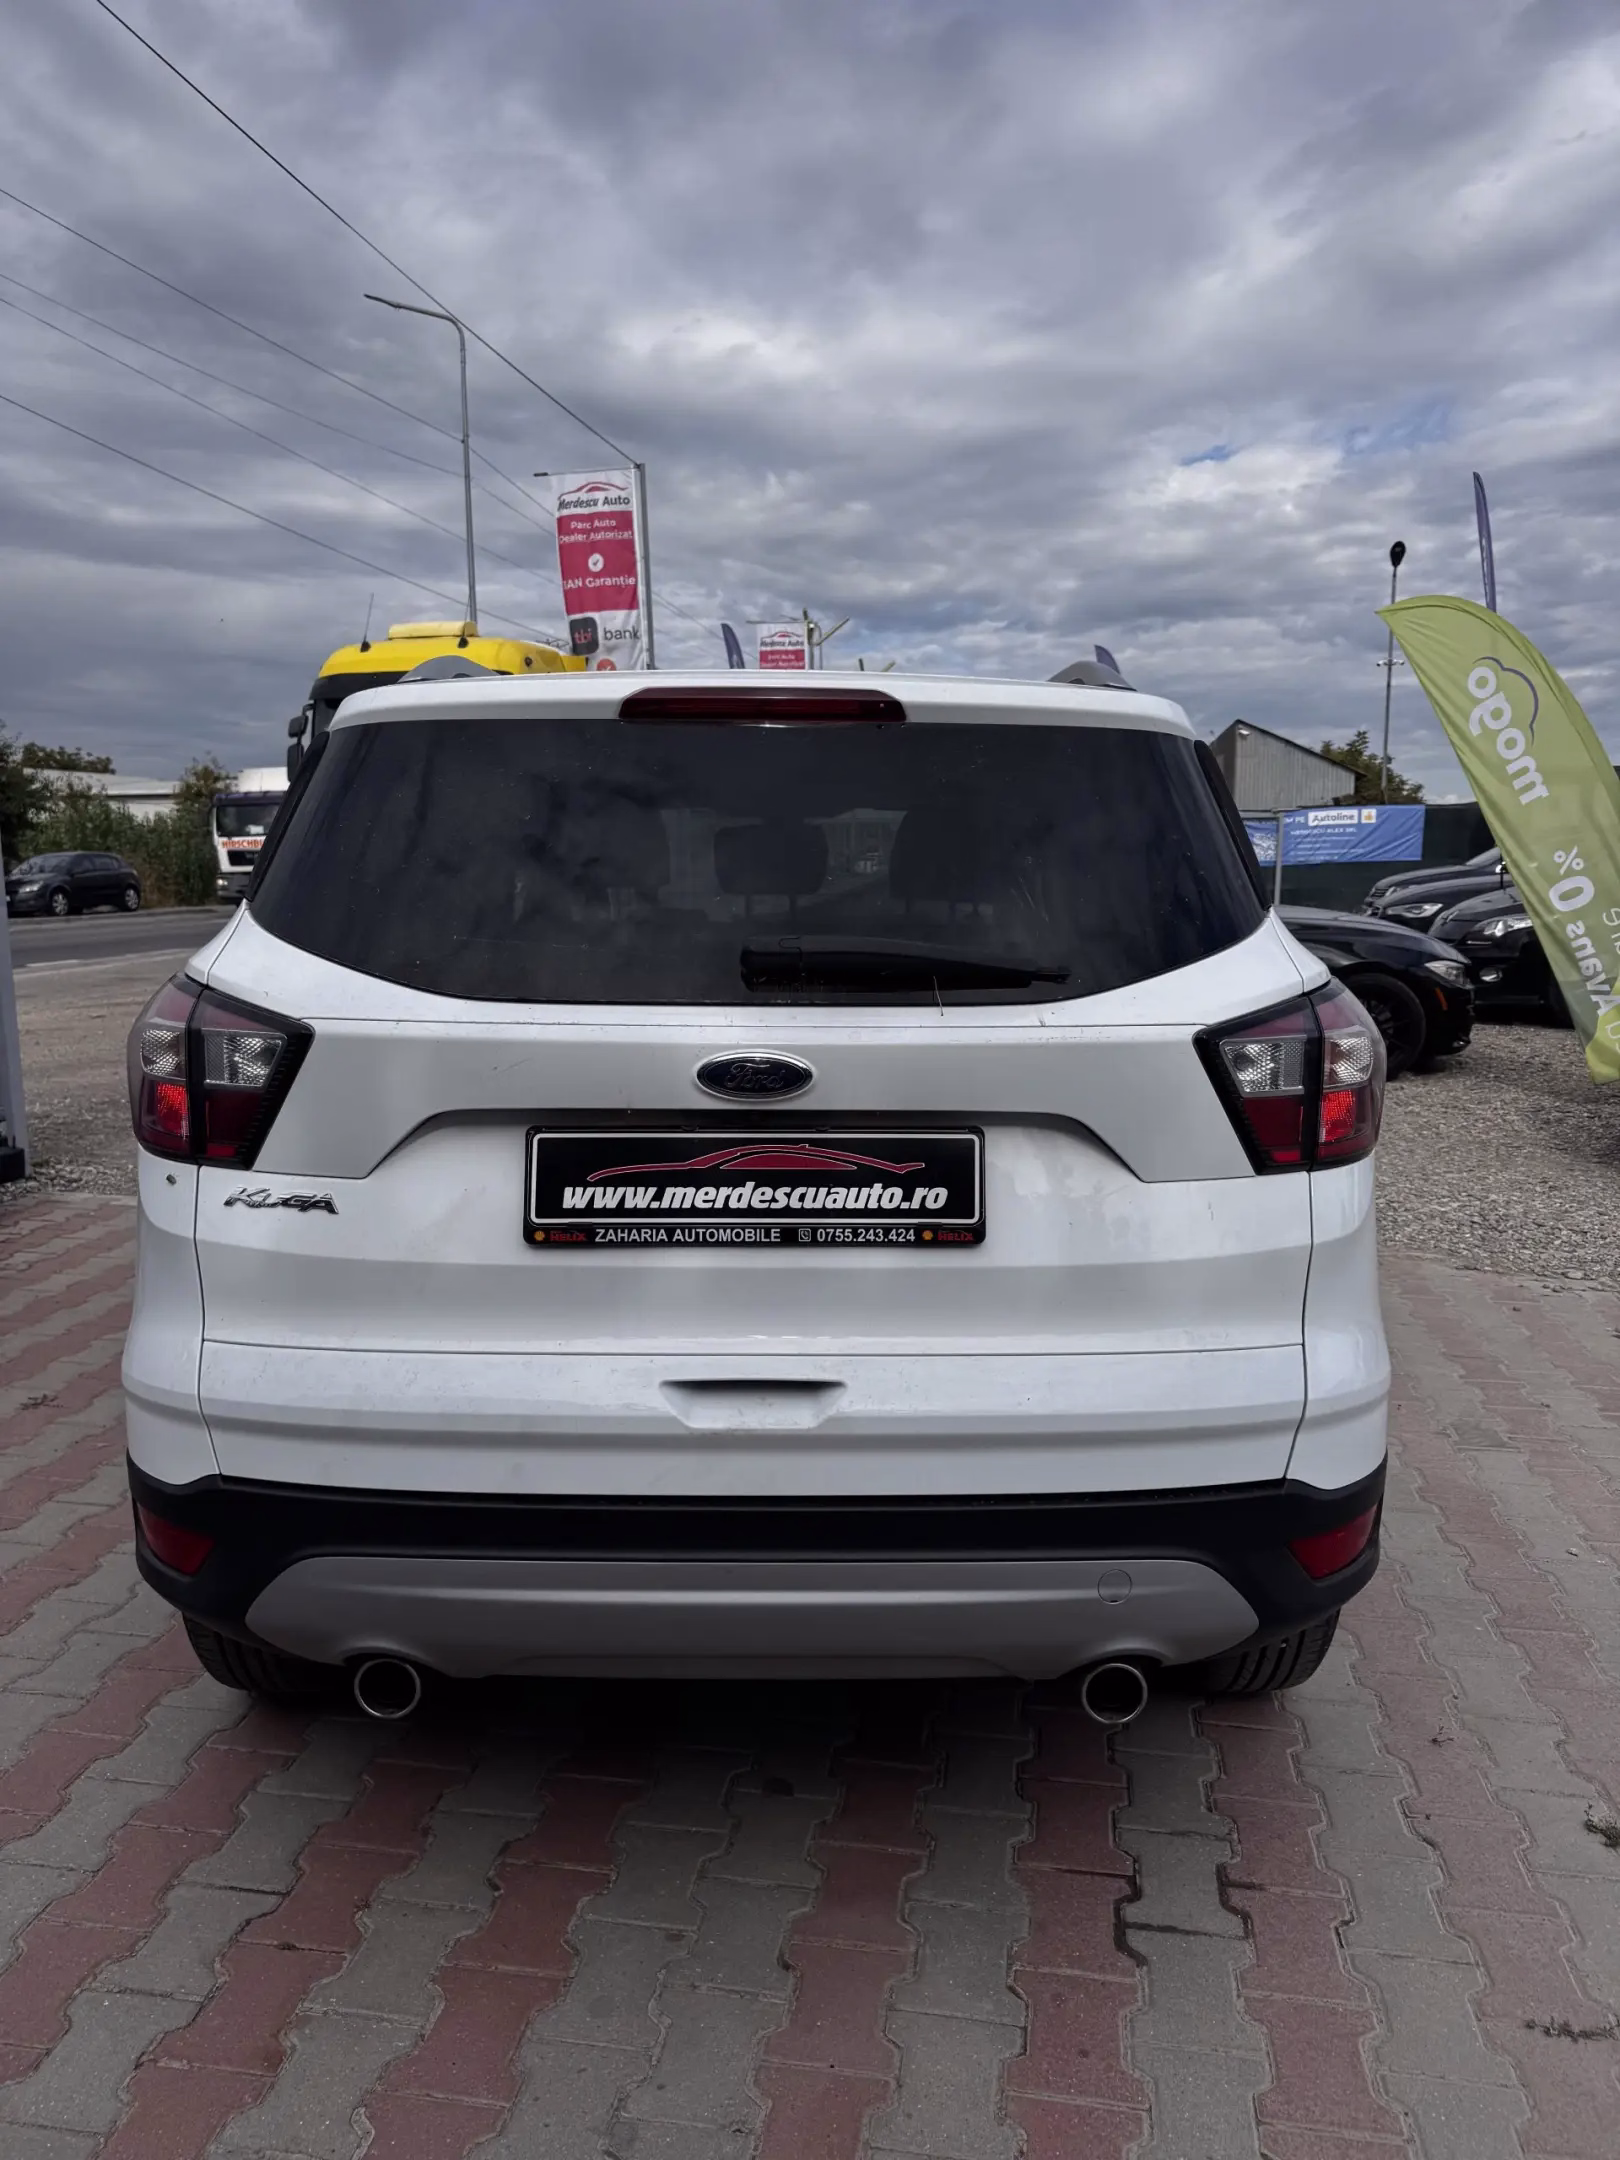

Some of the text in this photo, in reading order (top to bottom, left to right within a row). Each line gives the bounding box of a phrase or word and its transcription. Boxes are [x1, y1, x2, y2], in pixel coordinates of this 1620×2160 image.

[603, 496, 630, 506] Auto
[570, 519, 616, 529] Parc Auto
[589, 530, 632, 541] Autorizat
[574, 625, 640, 643] tbi bank
[1312, 812, 1355, 823] Autoline
[725, 1062, 785, 1089] Ford
[562, 1181, 948, 1209] www.merdescuauto.ro
[595, 1228, 668, 1242] ZAHARIA
[672, 1228, 781, 1242] AUTOMOBILE
[816, 1228, 915, 1242] 0755.243.424
